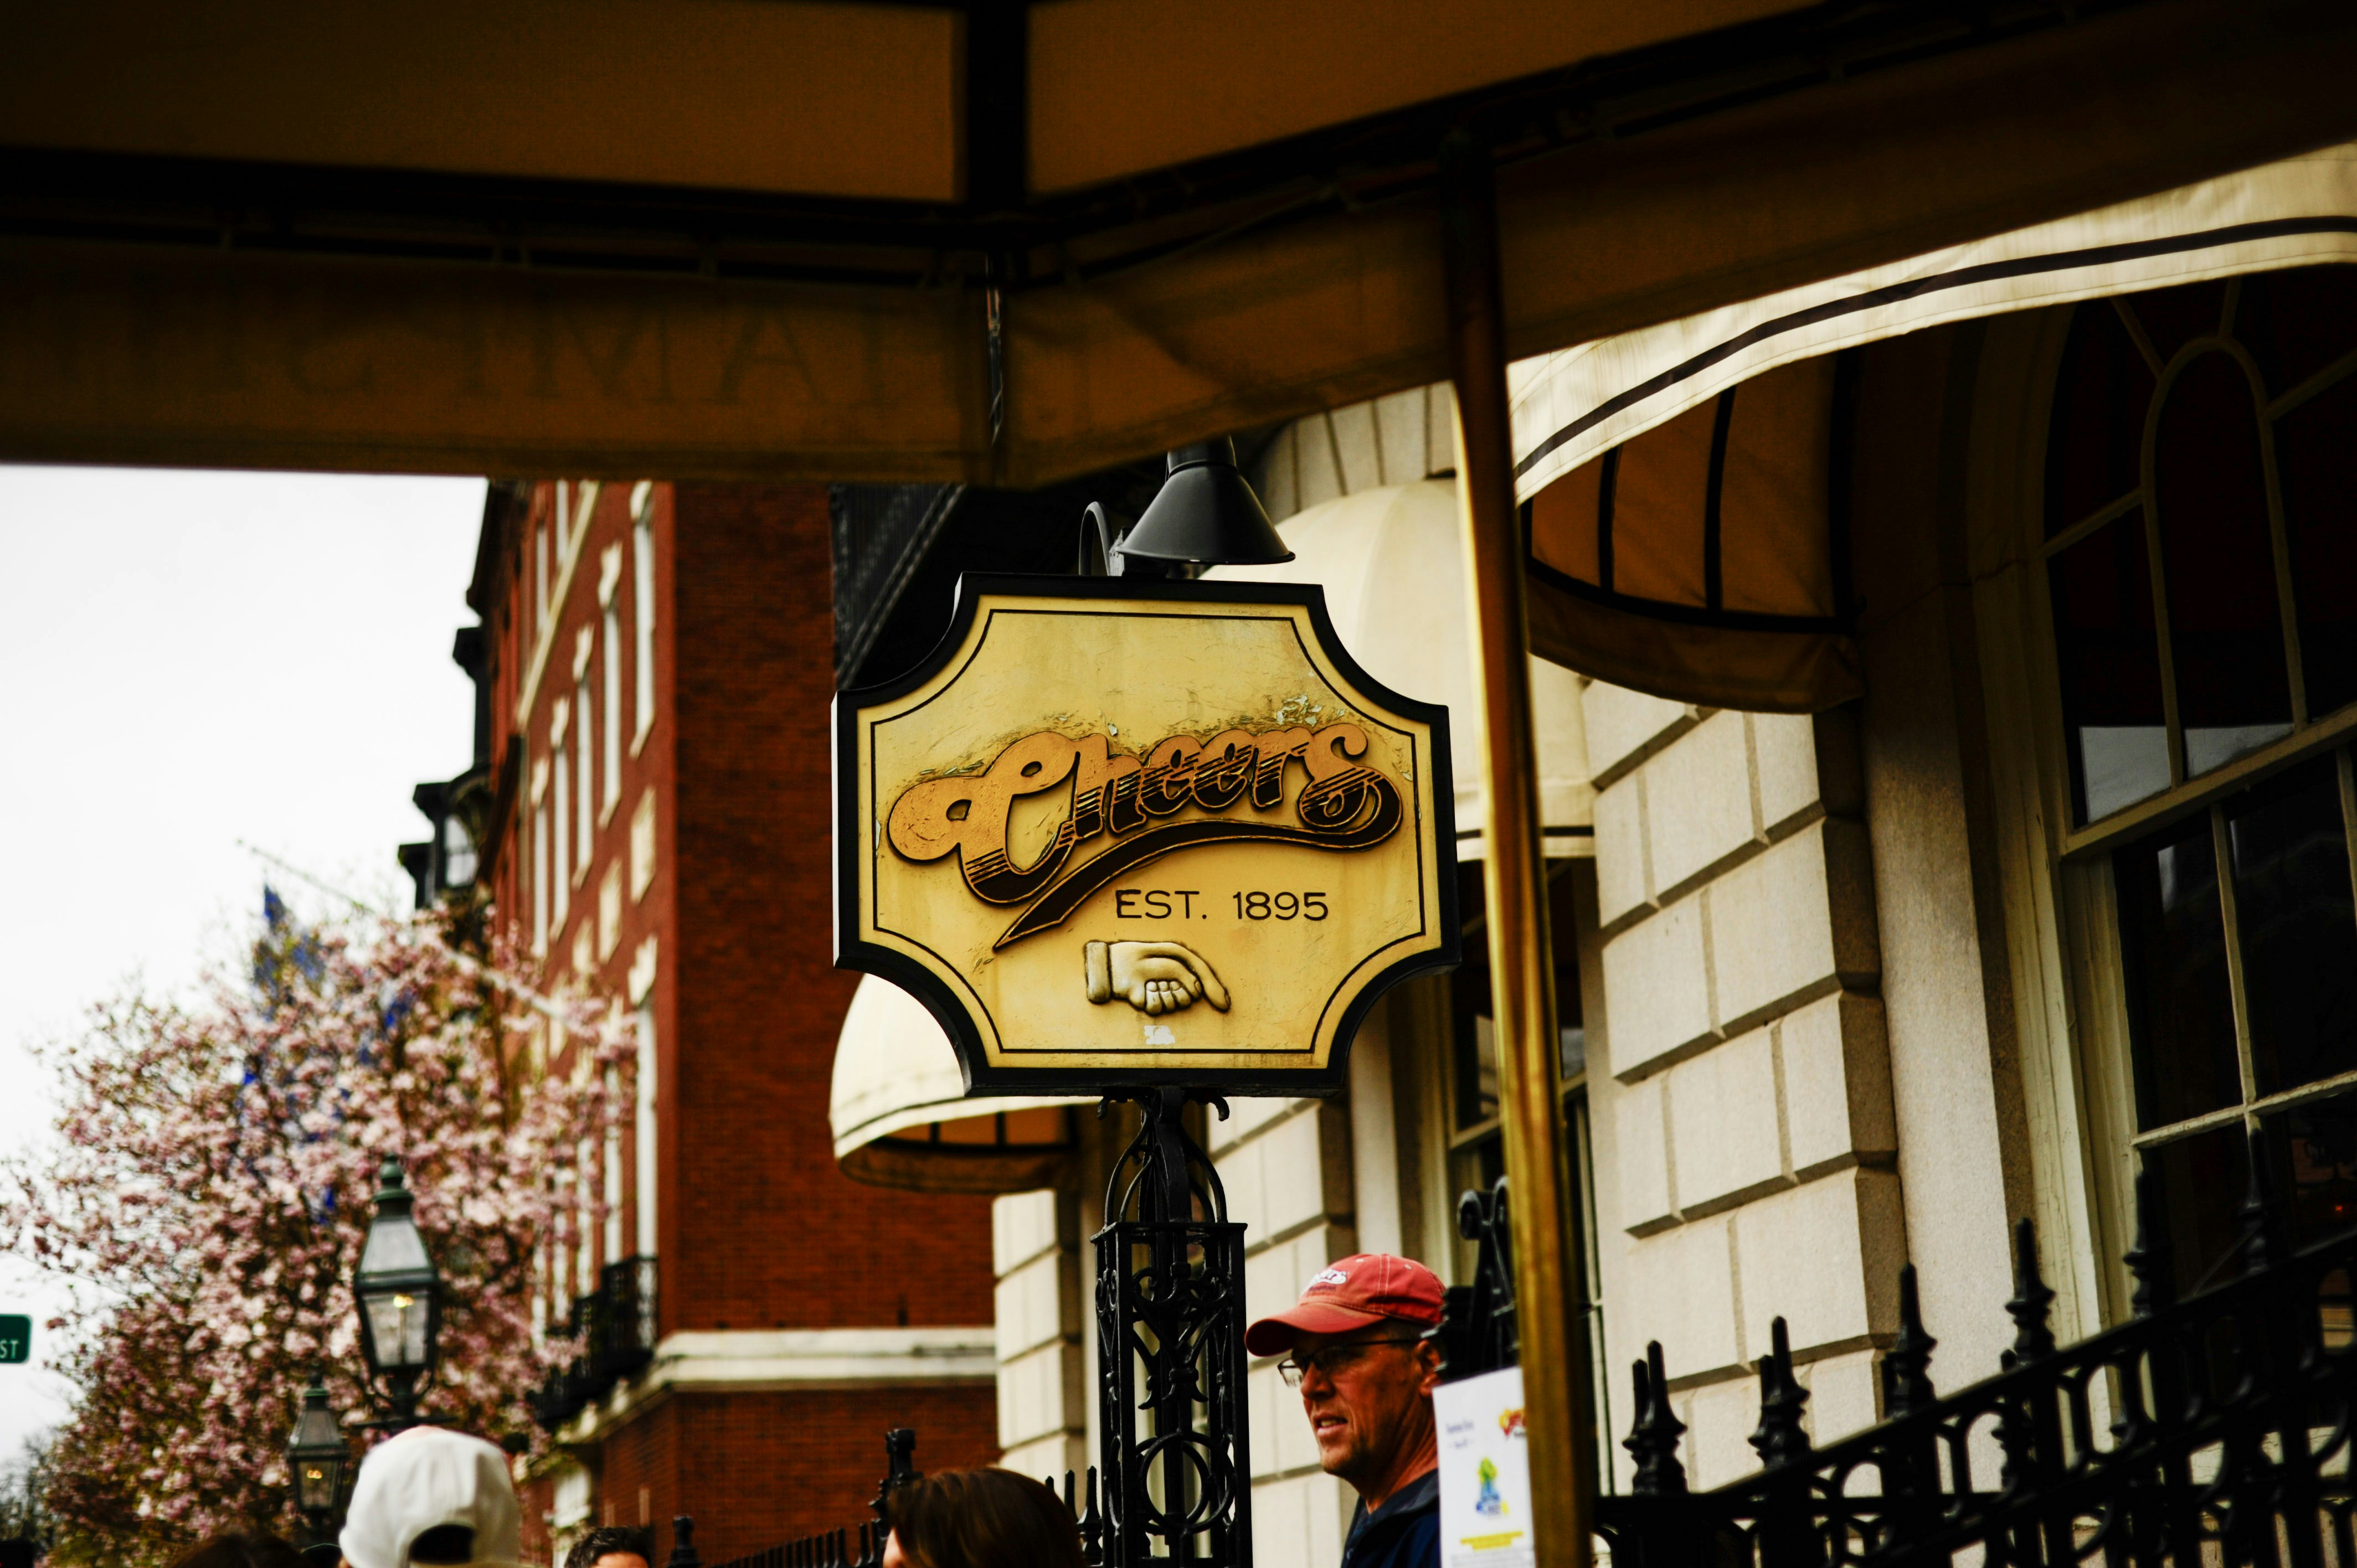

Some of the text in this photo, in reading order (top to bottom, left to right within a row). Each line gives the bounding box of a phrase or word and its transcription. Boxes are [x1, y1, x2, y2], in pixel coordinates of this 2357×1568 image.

[888, 723, 1403, 951] Cheers
[1115, 889, 1329, 921] EST. 1895
[0, 1339, 19, 1359] ST
